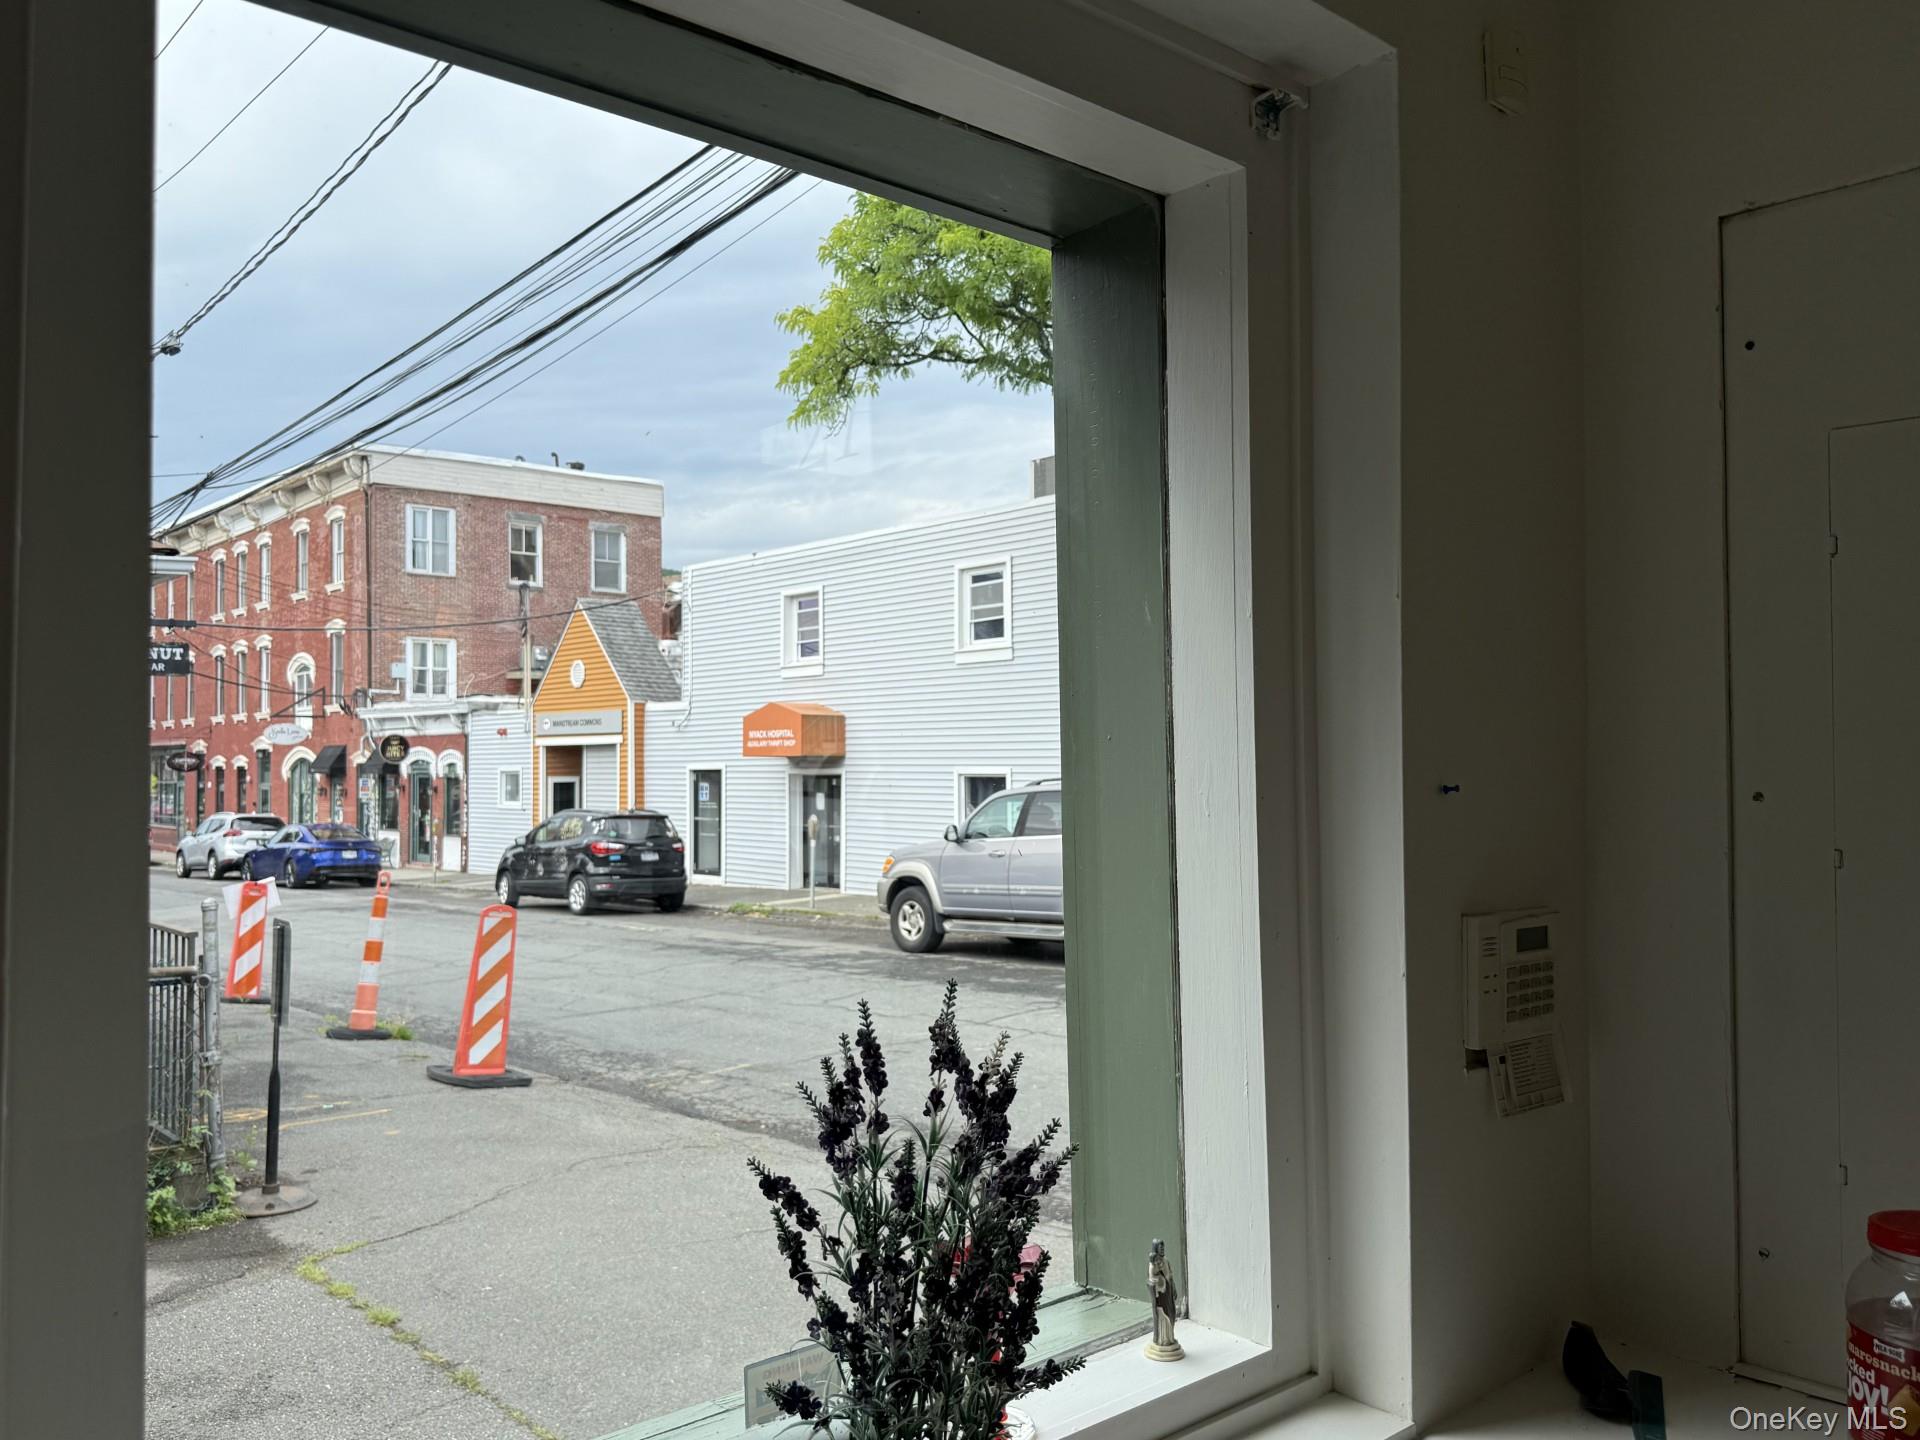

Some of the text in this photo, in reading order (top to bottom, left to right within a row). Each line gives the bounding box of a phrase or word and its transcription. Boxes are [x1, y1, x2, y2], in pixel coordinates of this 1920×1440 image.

[151, 662, 166, 671] AR
[749, 729, 794, 738] NYACK HOSPITAL
